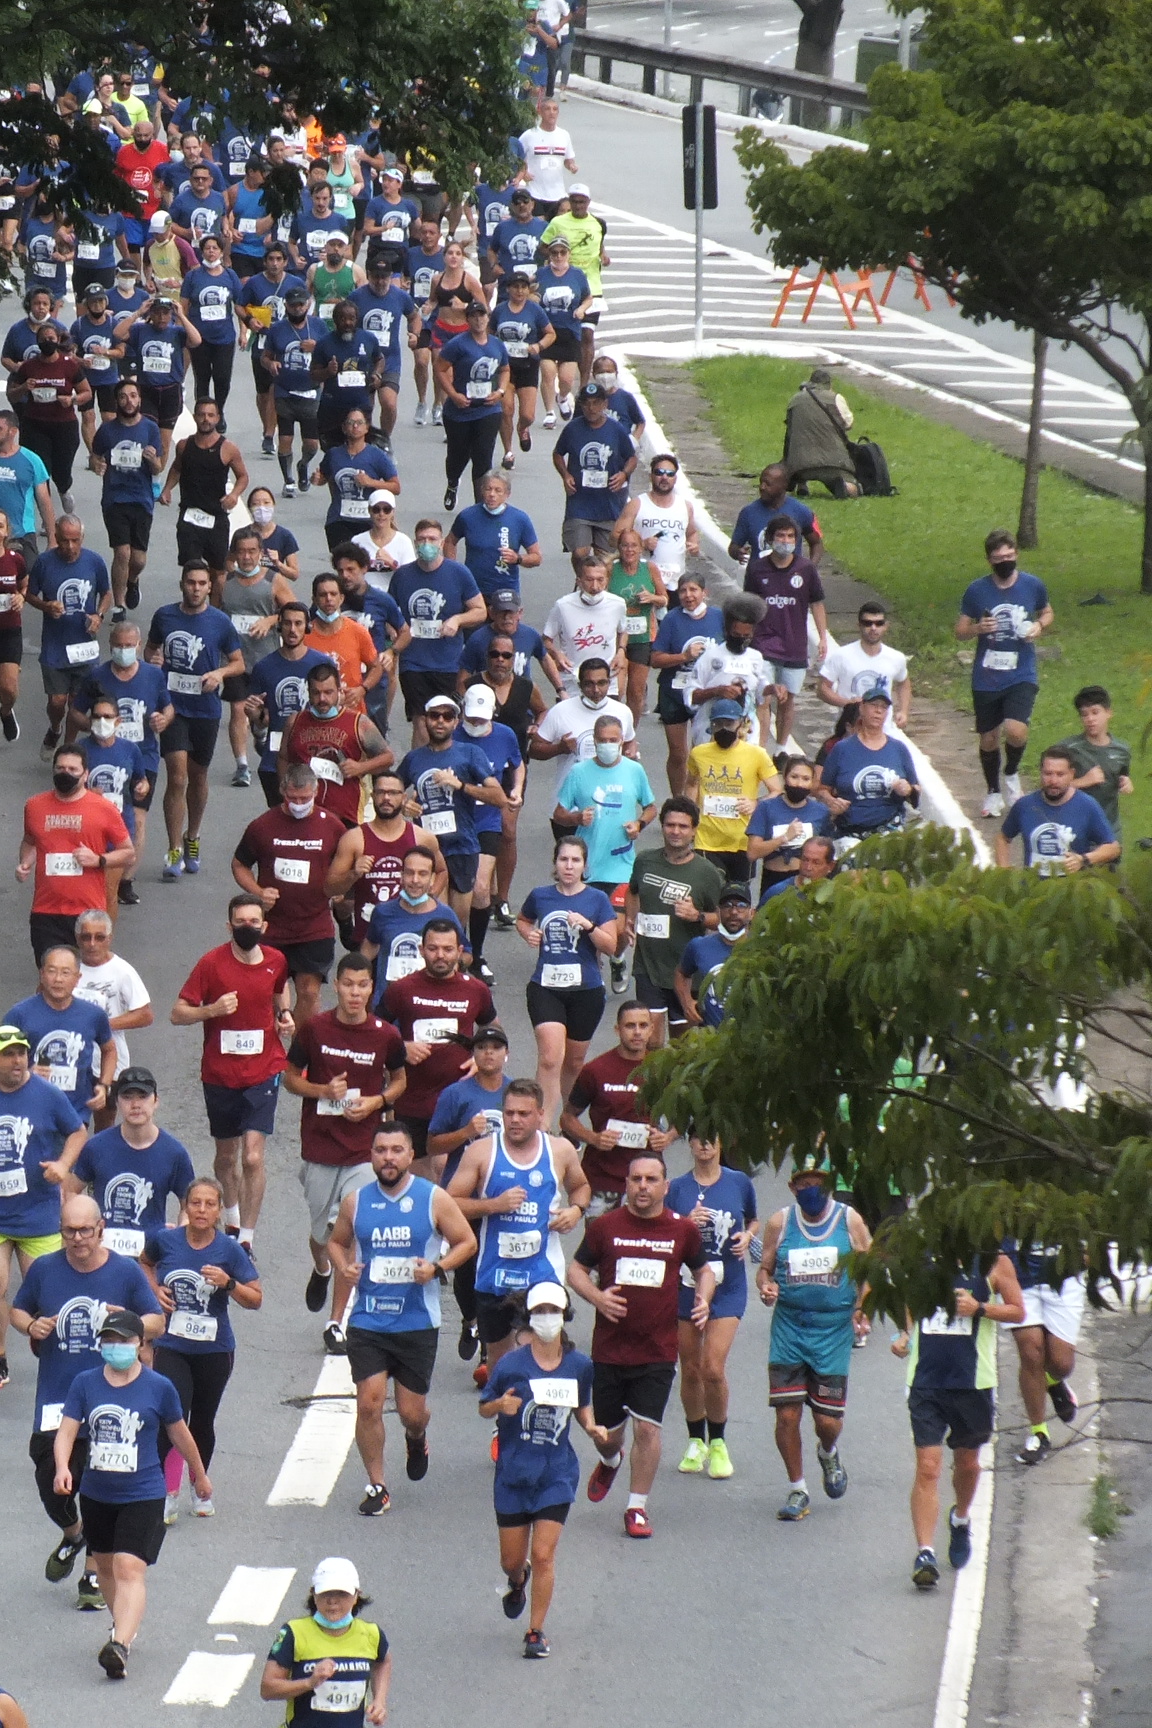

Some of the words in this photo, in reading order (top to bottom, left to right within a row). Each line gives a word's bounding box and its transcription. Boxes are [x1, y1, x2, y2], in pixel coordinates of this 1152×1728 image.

[273, 838, 323, 848] TransFerrari
[279, 866, 303, 878] 4018
[665, 886, 686, 897] RUN
[550, 971, 575, 982] 4729
[413, 996, 469, 1009] TransFerrari
[235, 1037, 256, 1049] 849
[321, 1045, 376, 1060] TransFerrari
[519, 1214, 538, 1223] PAULO
[371, 1226, 411, 1241] AABB
[111, 1238, 137, 1250] 1064
[372, 1239, 387, 1248] SÃO
[388, 1239, 412, 1248] PAULO
[508, 1241, 536, 1254] 3671
[613, 1237, 675, 1249] TransFerrari
[801, 1257, 830, 1269] 4905
[382, 1264, 411, 1277] 3672
[628, 1268, 656, 1282] 4002
[185, 1322, 206, 1335] 984
[545, 1387, 570, 1398] 4967
[99, 1453, 129, 1465] 4770
